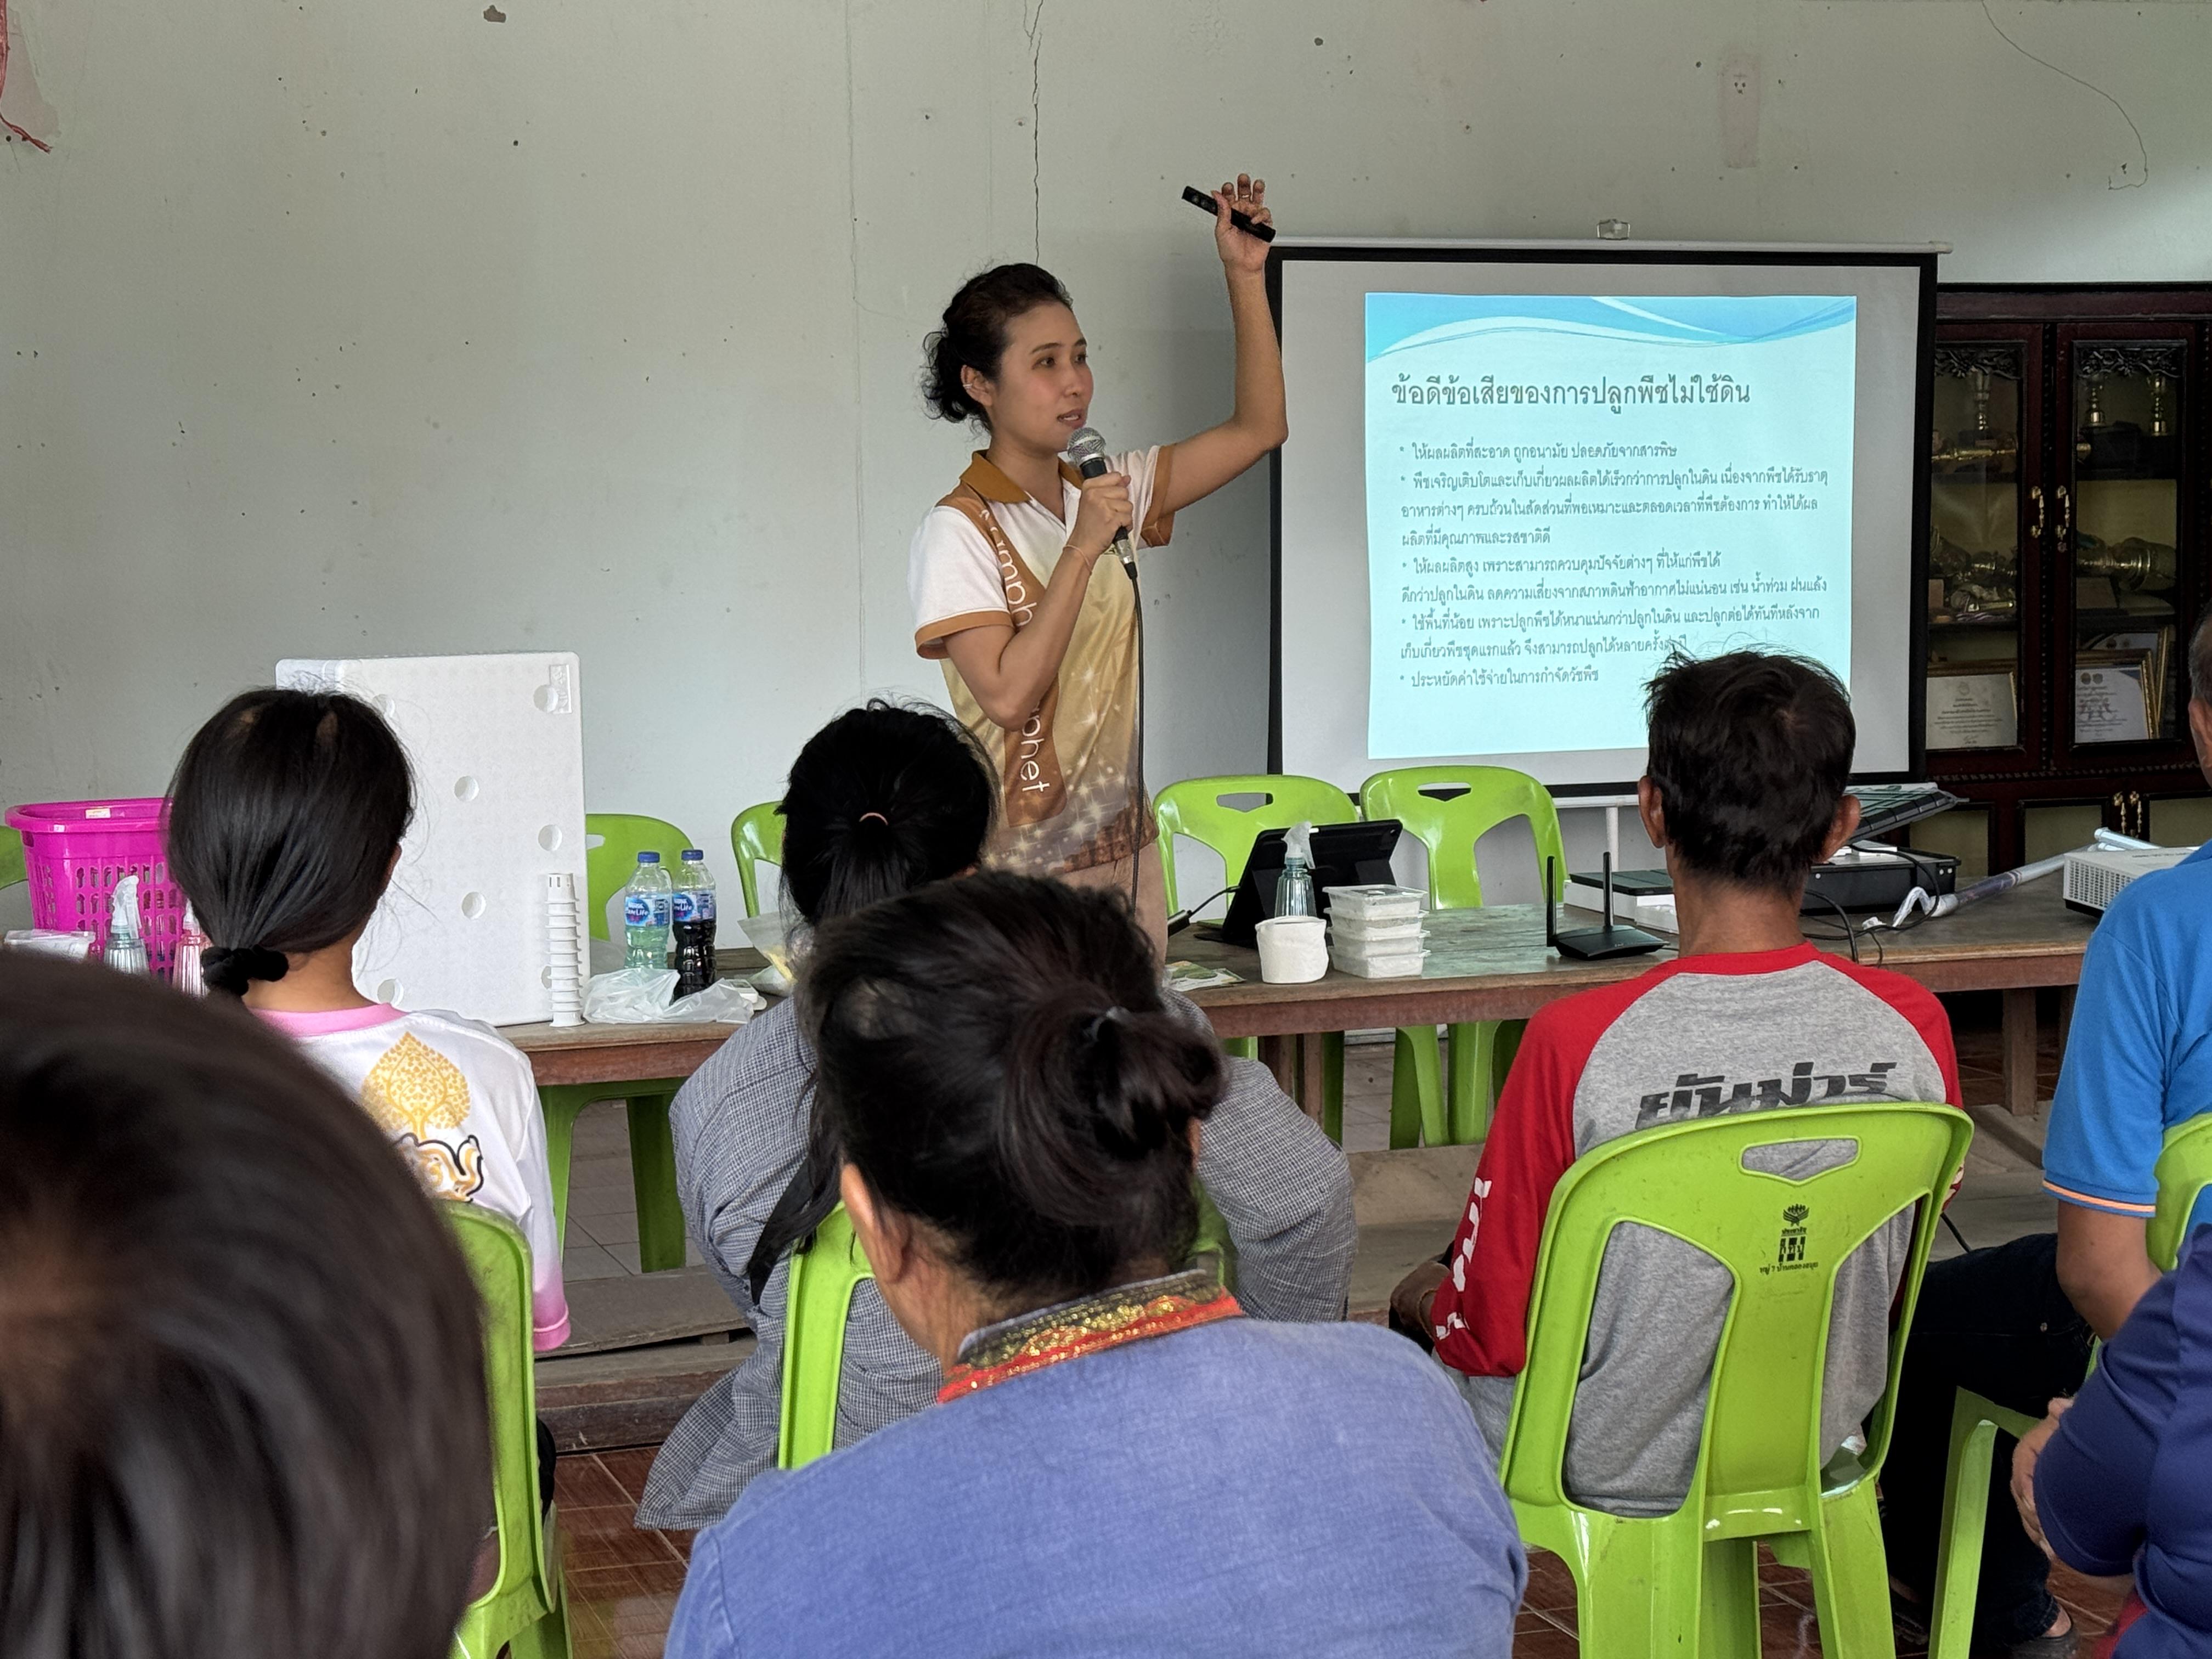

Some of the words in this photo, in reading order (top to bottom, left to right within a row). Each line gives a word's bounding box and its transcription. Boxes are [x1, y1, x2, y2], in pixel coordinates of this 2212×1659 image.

[1392, 373, 1750, 414] ข้อดีข้อเสียของการปลูกพืชไม่ใช้ดิน
[1412, 436, 1510, 459] ให้ผลผลิตที่สะอาด
[1514, 442, 1567, 462] ถูกอนามัย
